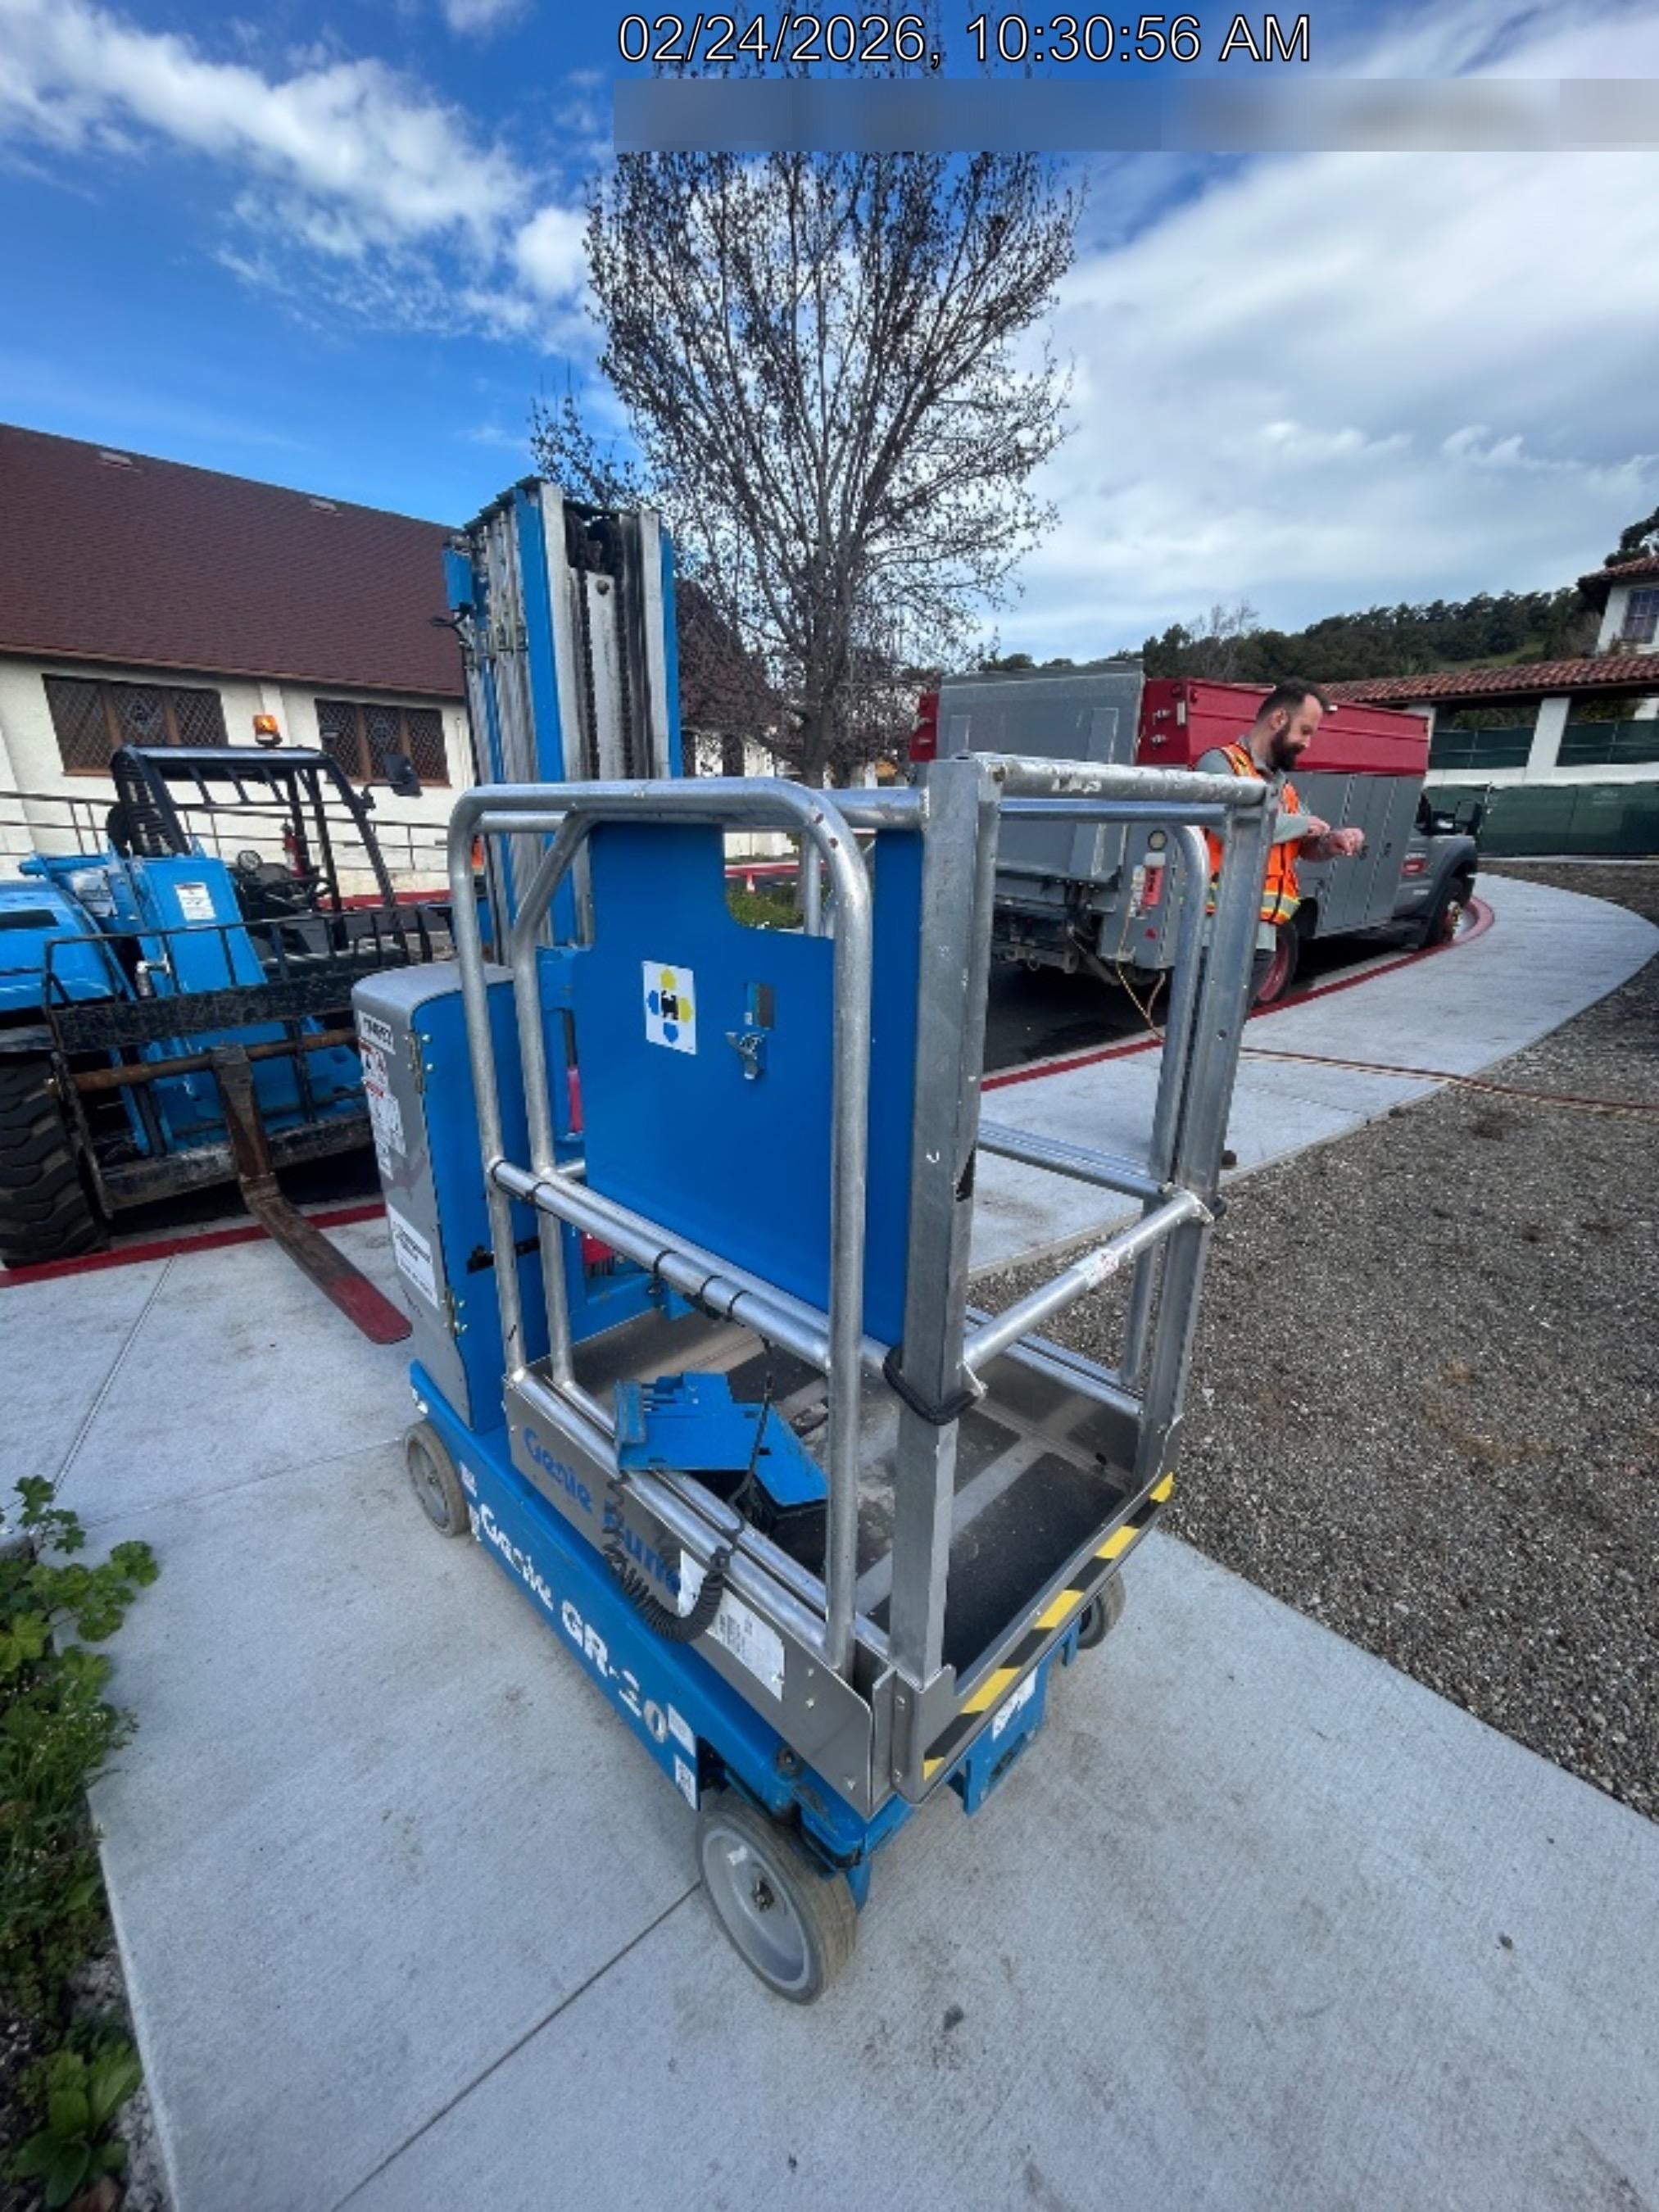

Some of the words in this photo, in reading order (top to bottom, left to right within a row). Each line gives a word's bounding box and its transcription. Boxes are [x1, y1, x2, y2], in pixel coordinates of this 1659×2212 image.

[524, 1426, 593, 1515] Genie
[480, 1503, 554, 1611] Genie
[561, 1599, 668, 1744] GR-20
